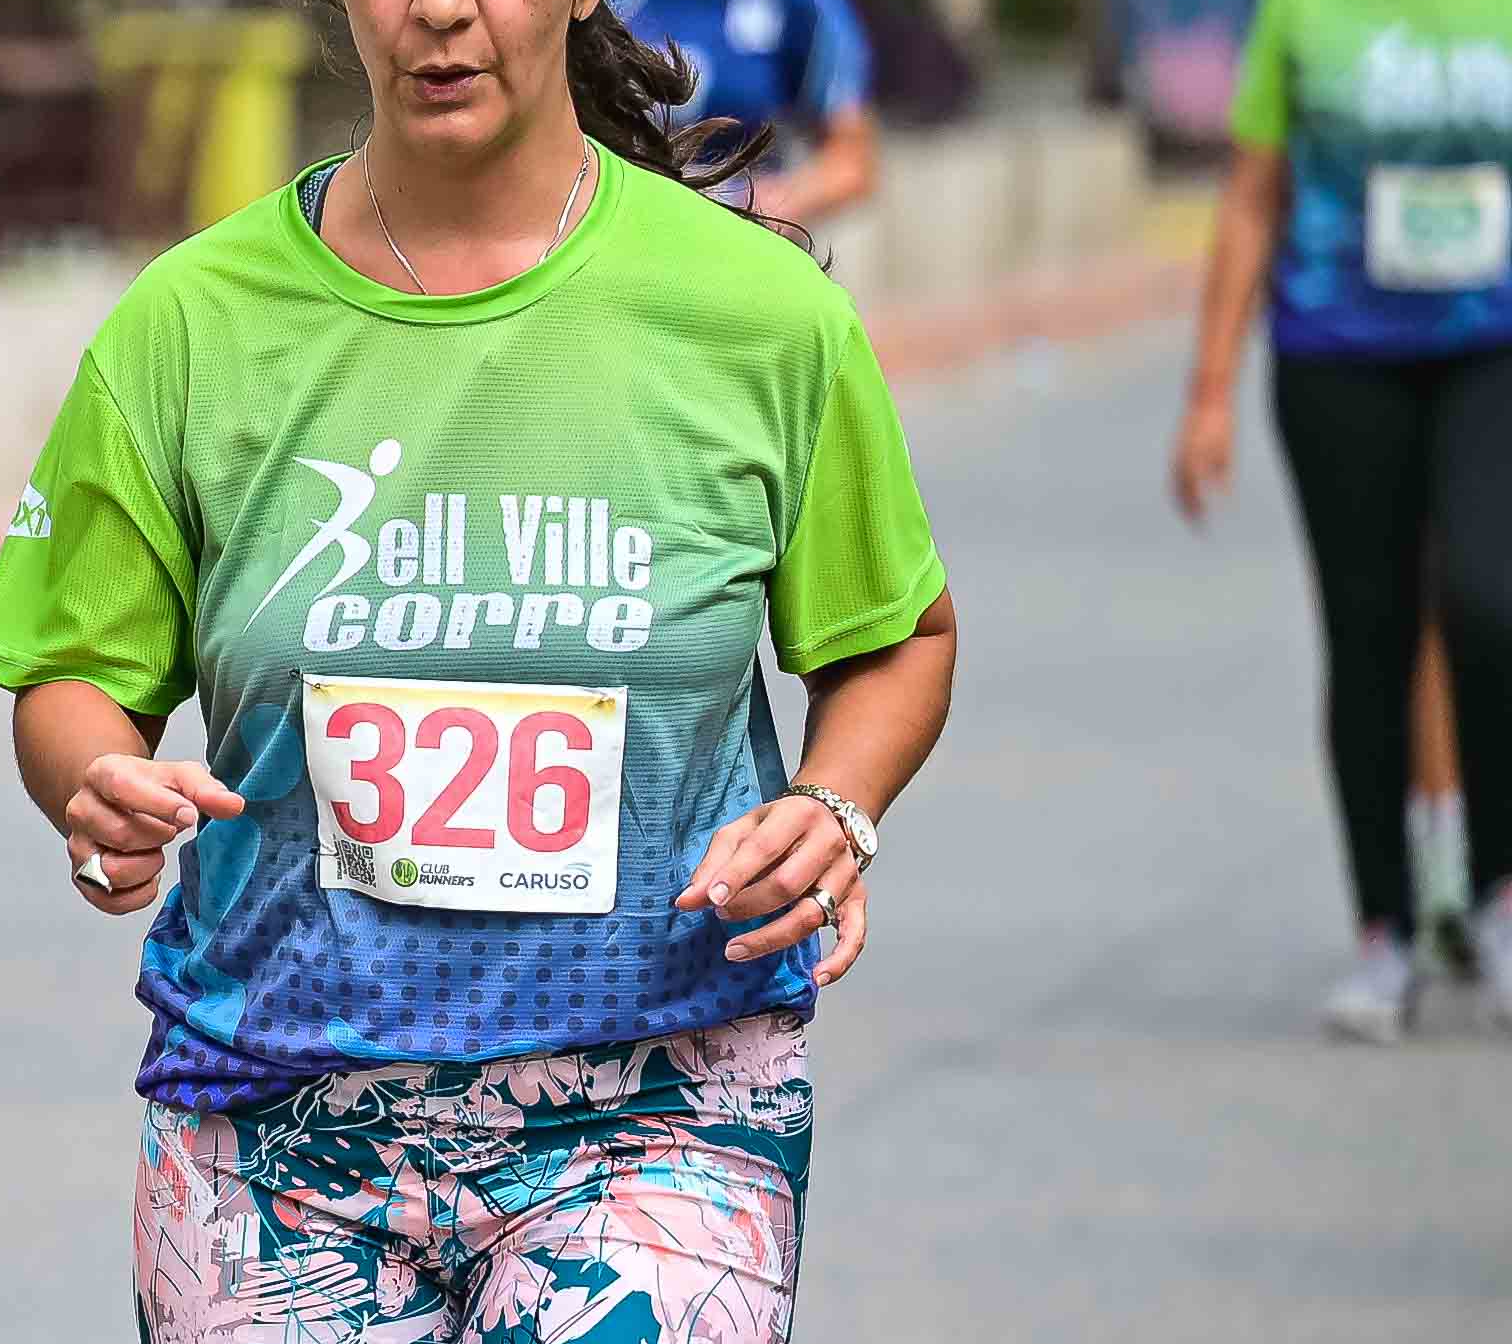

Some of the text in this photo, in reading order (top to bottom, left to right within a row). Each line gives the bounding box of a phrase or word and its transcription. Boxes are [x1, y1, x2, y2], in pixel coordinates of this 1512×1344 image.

[499, 494, 653, 591] Ville
[302, 592, 654, 653] corre
[326, 702, 593, 853] 326
[419, 874, 476, 887] RUNNER'S
[420, 863, 450, 874] CLUB
[499, 872, 589, 890] CARUSO
